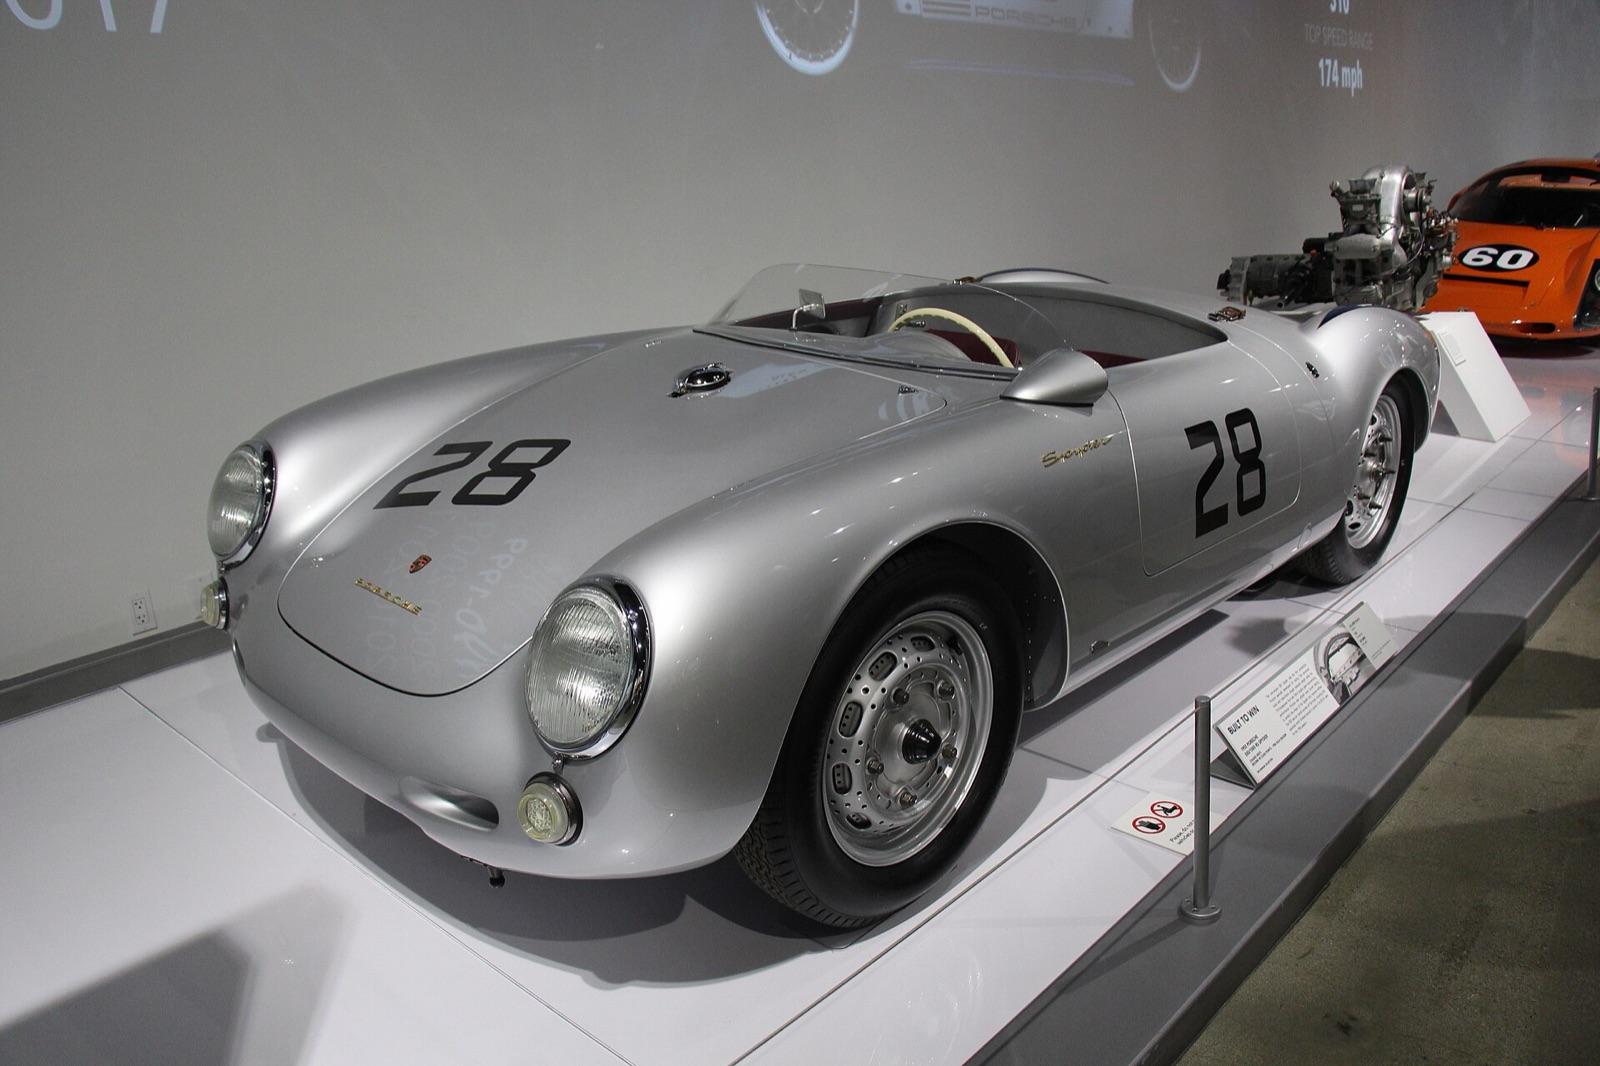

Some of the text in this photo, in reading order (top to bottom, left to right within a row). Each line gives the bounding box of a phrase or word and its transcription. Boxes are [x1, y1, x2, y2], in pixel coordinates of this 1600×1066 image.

[975, 6, 1077, 28] PORSCHE
[1322, 26, 1348, 48] SPEED
[1319, 58, 1363, 97] 174 mph
[1462, 247, 1534, 270] 60
[1041, 436, 1113, 468] Spyder
[373, 439, 571, 509] 28
[1184, 408, 1266, 538] 28
[354, 577, 422, 616] PORSCHE
[1227, 704, 1260, 735] BUILT TO WIN
